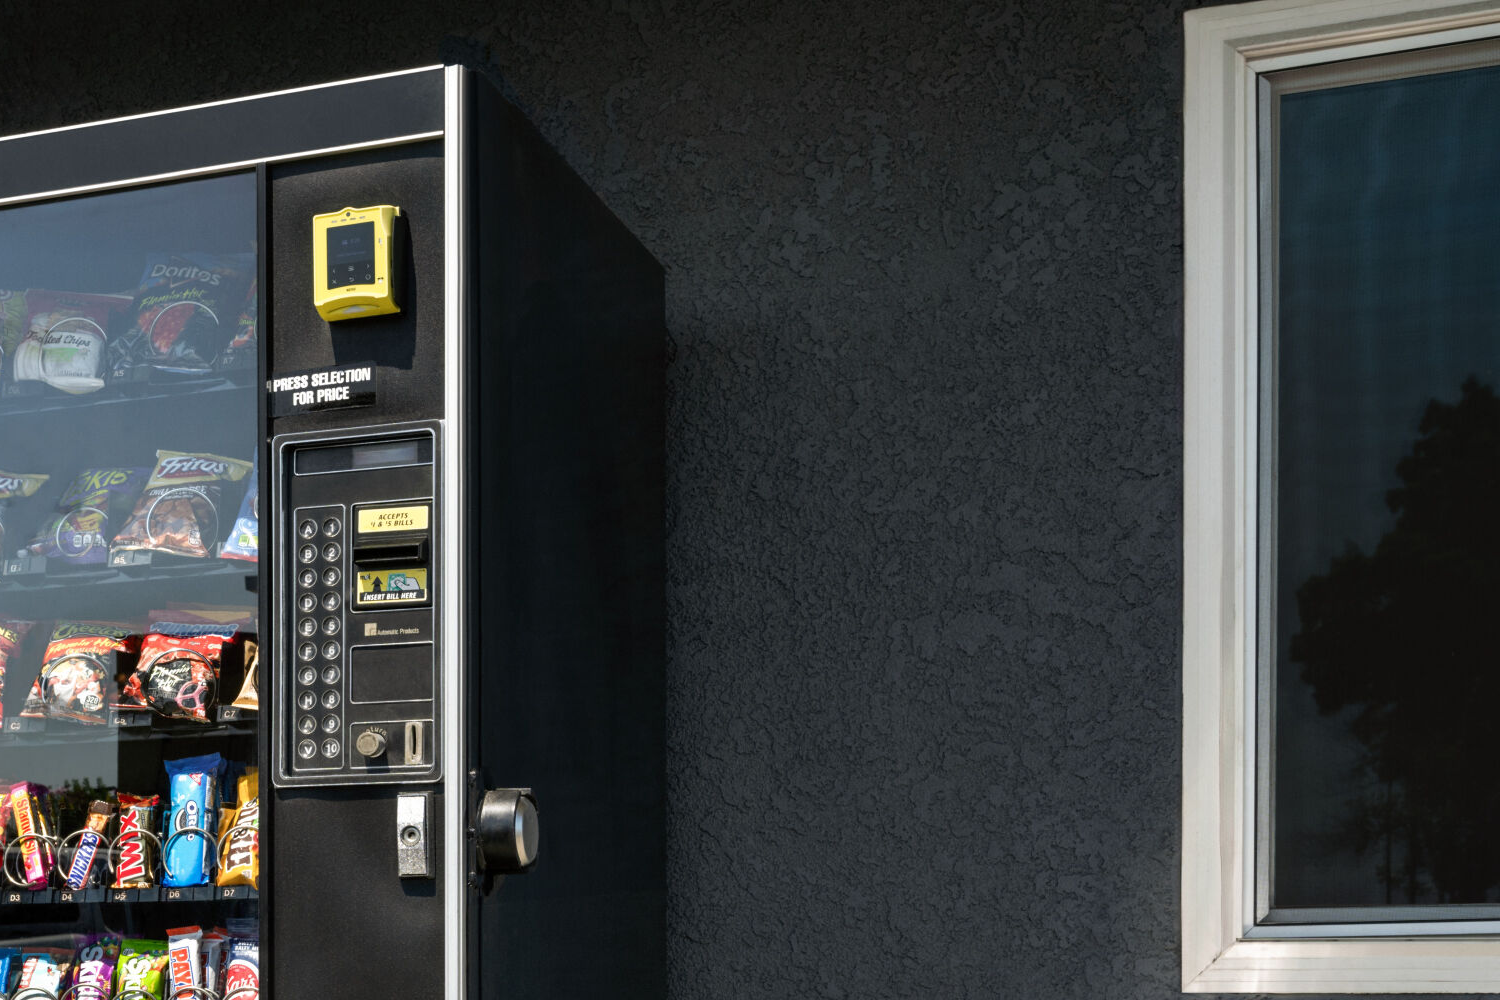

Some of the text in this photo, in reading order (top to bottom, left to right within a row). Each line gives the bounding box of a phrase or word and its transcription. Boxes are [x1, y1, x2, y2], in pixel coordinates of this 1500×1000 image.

[151, 264, 222, 286] Doritos
[63, 334, 91, 347] Chips
[273, 367, 371, 393] PRESS SELECTION
[293, 386, 350, 406] FOR PRICE
[156, 456, 229, 479] Fritos
[378, 512, 408, 520] ACCEPTS
[329, 523, 334, 533] 1
[394, 519, 414, 527] BILLS
[304, 524, 312, 535] A
[304, 549, 312, 559] B
[328, 548, 336, 557] 2
[304, 573, 312, 583] C
[328, 572, 336, 582] 3
[328, 596, 336, 606] 4
[363, 591, 418, 601] INSERT BILL HERE
[304, 598, 312, 607] D
[304, 622, 312, 632] E
[328, 621, 335, 631] 5
[399, 627, 420, 635] Products
[52, 623, 128, 640] Cheetos
[304, 646, 312, 657] F
[328, 645, 335, 655] 6
[304, 671, 313, 681] G
[329, 670, 335, 680] 7
[304, 695, 312, 706] H
[328, 694, 335, 704] 8
[224, 710, 236, 719] C7
[328, 719, 335, 729] 9
[326, 742, 337, 754] 10
[185, 799, 199, 842] ORO
[117, 809, 145, 887] TWIX
[66, 831, 99, 889] SNICKERS
[10, 894, 21, 902] D3
[169, 890, 180, 898] D6
[224, 889, 235, 897] D7
